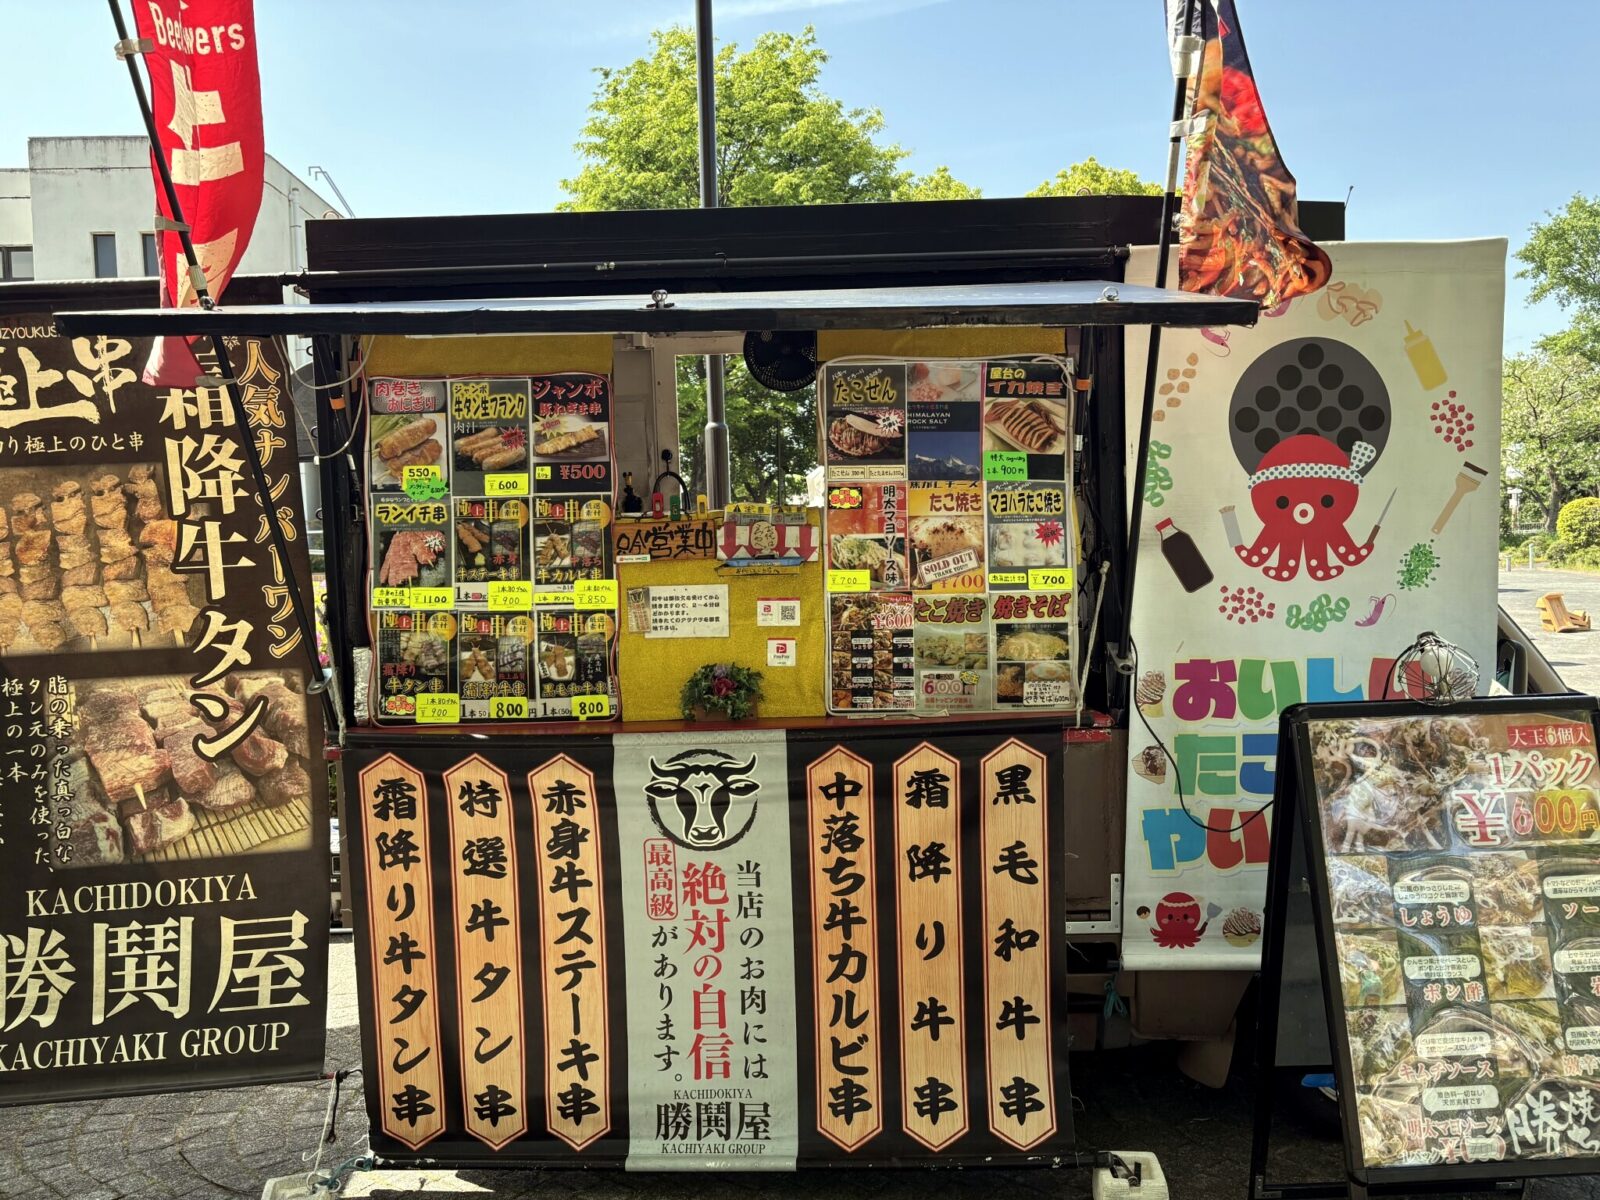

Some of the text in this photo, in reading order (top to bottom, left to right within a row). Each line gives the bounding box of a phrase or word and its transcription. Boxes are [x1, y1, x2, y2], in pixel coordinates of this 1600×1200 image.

[990, 368, 1025, 379] 屋台の
[375, 381, 421, 397] 肉巻き
[455, 384, 488, 394] ジャンボ
[532, 380, 603, 400] ジャンボ
[836, 379, 895, 402] たこせん
[988, 381, 1063, 395] イカ焼き
[387, 396, 436, 412] おにぎり
[454, 396, 524, 418] 牛タン生フランク
[539, 403, 602, 416] 豚ねぎま串
[453, 422, 475, 433] 肉汁
[560, 464, 606, 480] ¥500
[498, 480, 518, 490] 600
[377, 505, 446, 522] ランイチ串
[929, 492, 982, 513] たこ焼き
[883, 485, 898, 584] 明太マヨソース味
[923, 551, 974, 575] SOLD OUT
[933, 569, 952, 578] THANK
[1042, 575, 1065, 584] 700
[587, 596, 606, 604] 850
[914, 597, 986, 623] たこ焼き
[992, 593, 1071, 620] 焼きそば
[386, 676, 443, 694] 牛タン串
[496, 702, 523, 718] 800
[579, 702, 604, 715] 800
[1, 677, 29, 784] 極上の一本
[1509, 726, 1592, 747] 大玉6個入
[48, 675, 74, 864] 脂の乗った真っ白な
[1173, 733, 1279, 796] たこ
[1486, 749, 1597, 788] 1パック
[26, 872, 258, 917] KACHIDOKIYA
[1399, 904, 1473, 927] しょうゆ
[372, 777, 436, 1128] 霜降り牛タン串
[458, 779, 518, 1128] 特選牛タン串
[541, 779, 601, 1128] 赤身牛ステーキ串
[818, 772, 873, 1127] 中落ち牛カルビ串
[905, 767, 958, 1127] 霜降り牛串
[992, 763, 1045, 1127] 黒毛和牛串
[646, 843, 683, 1082] 最高級 があります。
[681, 860, 735, 1081] 絶対の自信
[736, 859, 769, 1080] 当店のお肉には
[1423, 982, 1485, 1003] ポン酢
[181, 1022, 290, 1059] GROUP
[1398, 1060, 1495, 1083] キムチソース
[673, 1088, 753, 1100] KACHIDOKIYA
[1405, 1115, 1504, 1140] 明太マヨソース
[661, 1143, 766, 1155] KACHIYAKI GROUP
